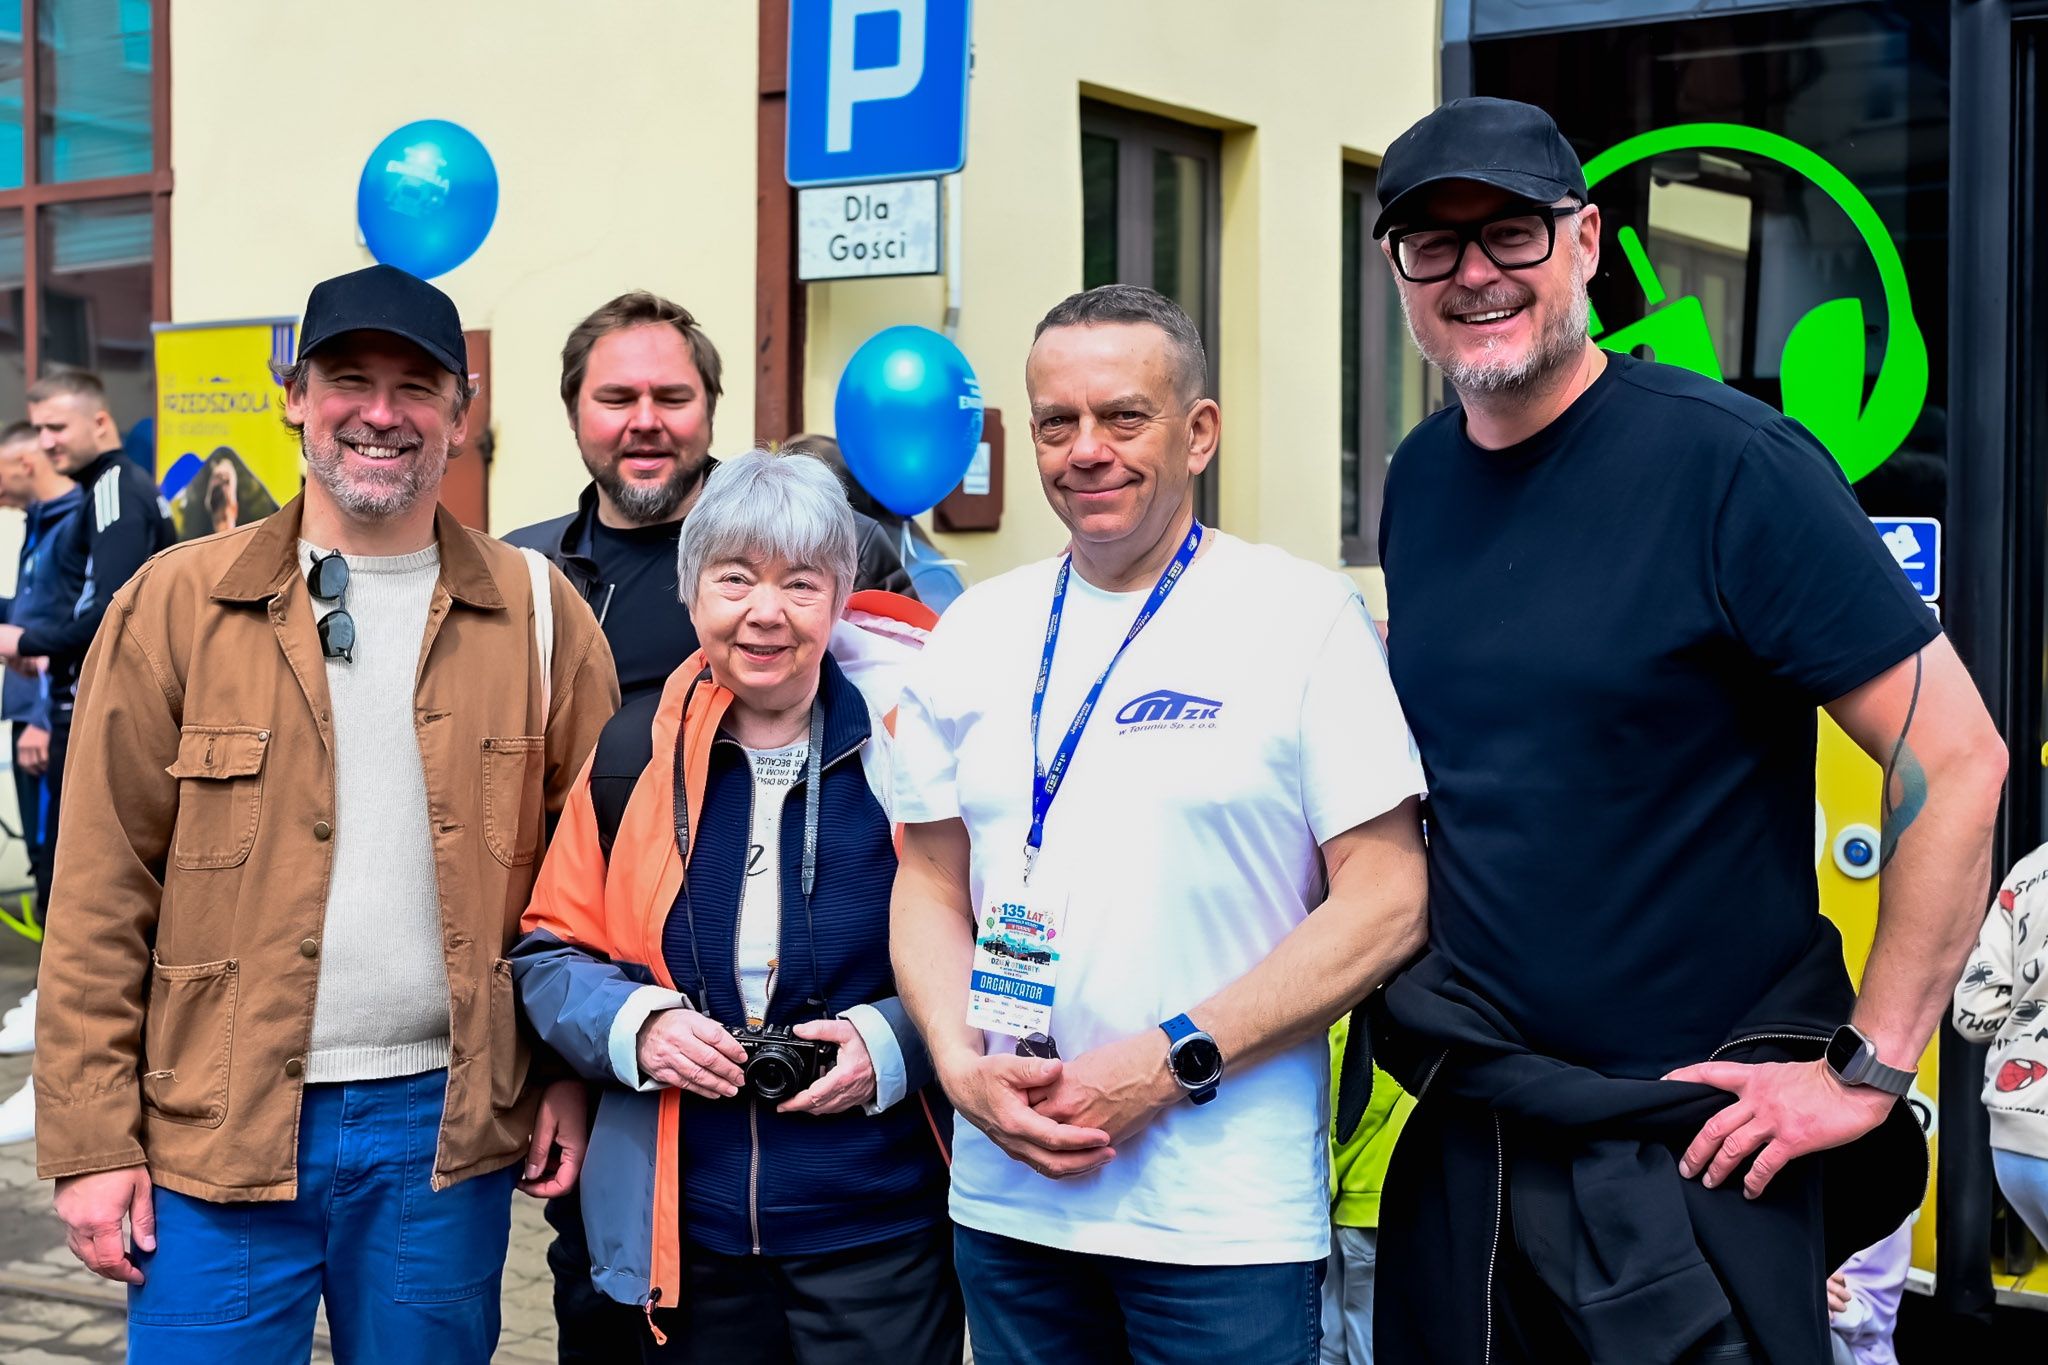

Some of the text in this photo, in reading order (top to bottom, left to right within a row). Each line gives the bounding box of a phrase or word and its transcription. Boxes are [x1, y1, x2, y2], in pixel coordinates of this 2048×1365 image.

[825, 0, 927, 154] P
[844, 195, 889, 222] Dla
[829, 231, 907, 261] Gości
[1129, 722, 1168, 734] Toruniu
[756, 756, 791, 768] BECAUSE
[1001, 902, 1026, 918] 135
[1026, 909, 1044, 923] LAT
[980, 975, 1043, 1000] ORGANIZATOR
